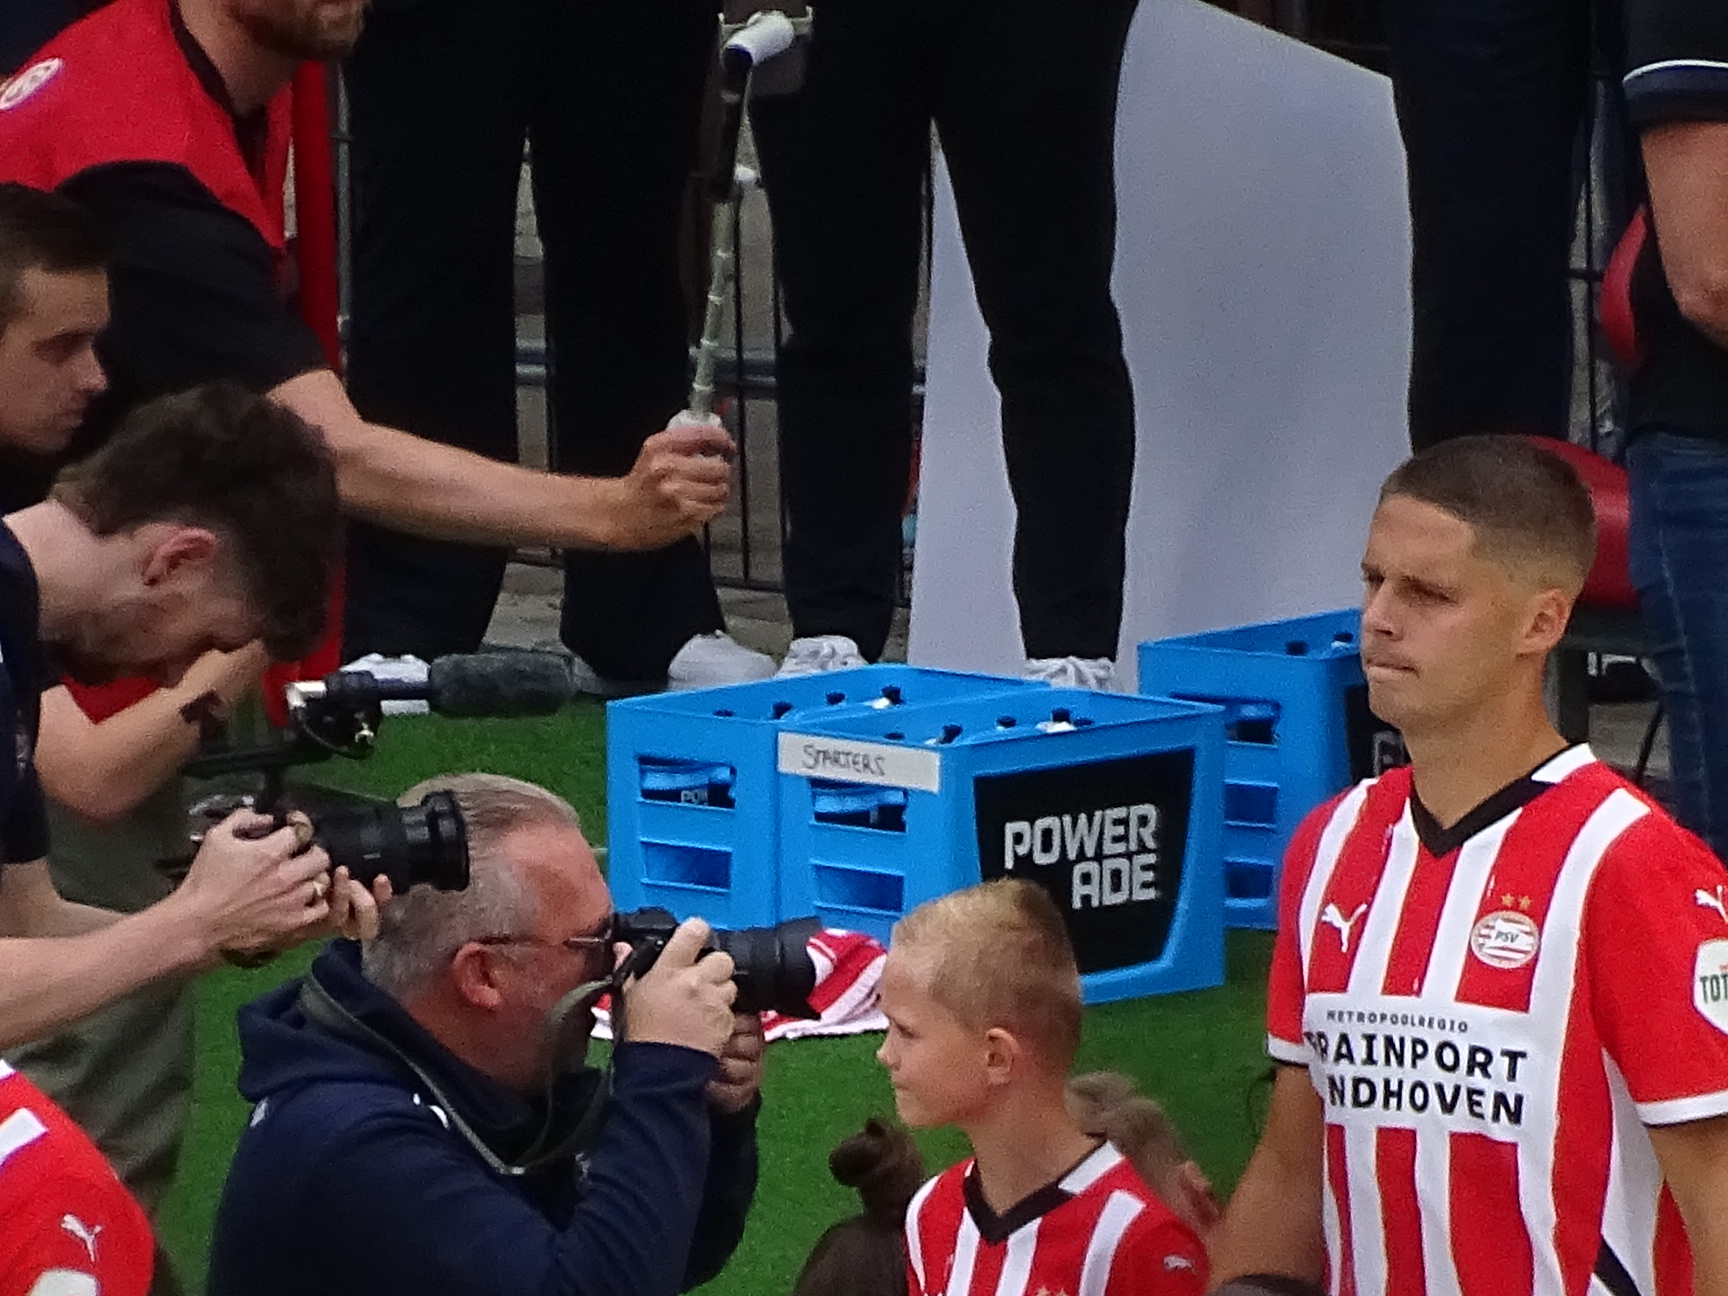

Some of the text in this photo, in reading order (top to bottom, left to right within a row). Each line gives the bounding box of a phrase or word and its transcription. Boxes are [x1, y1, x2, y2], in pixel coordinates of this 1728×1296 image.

[1004, 802, 1159, 869] POWER
[1072, 853, 1158, 910] ADE
[1494, 931, 1520, 943] PSV
[1325, 1008, 1470, 1034] METROPOOLREGIO
